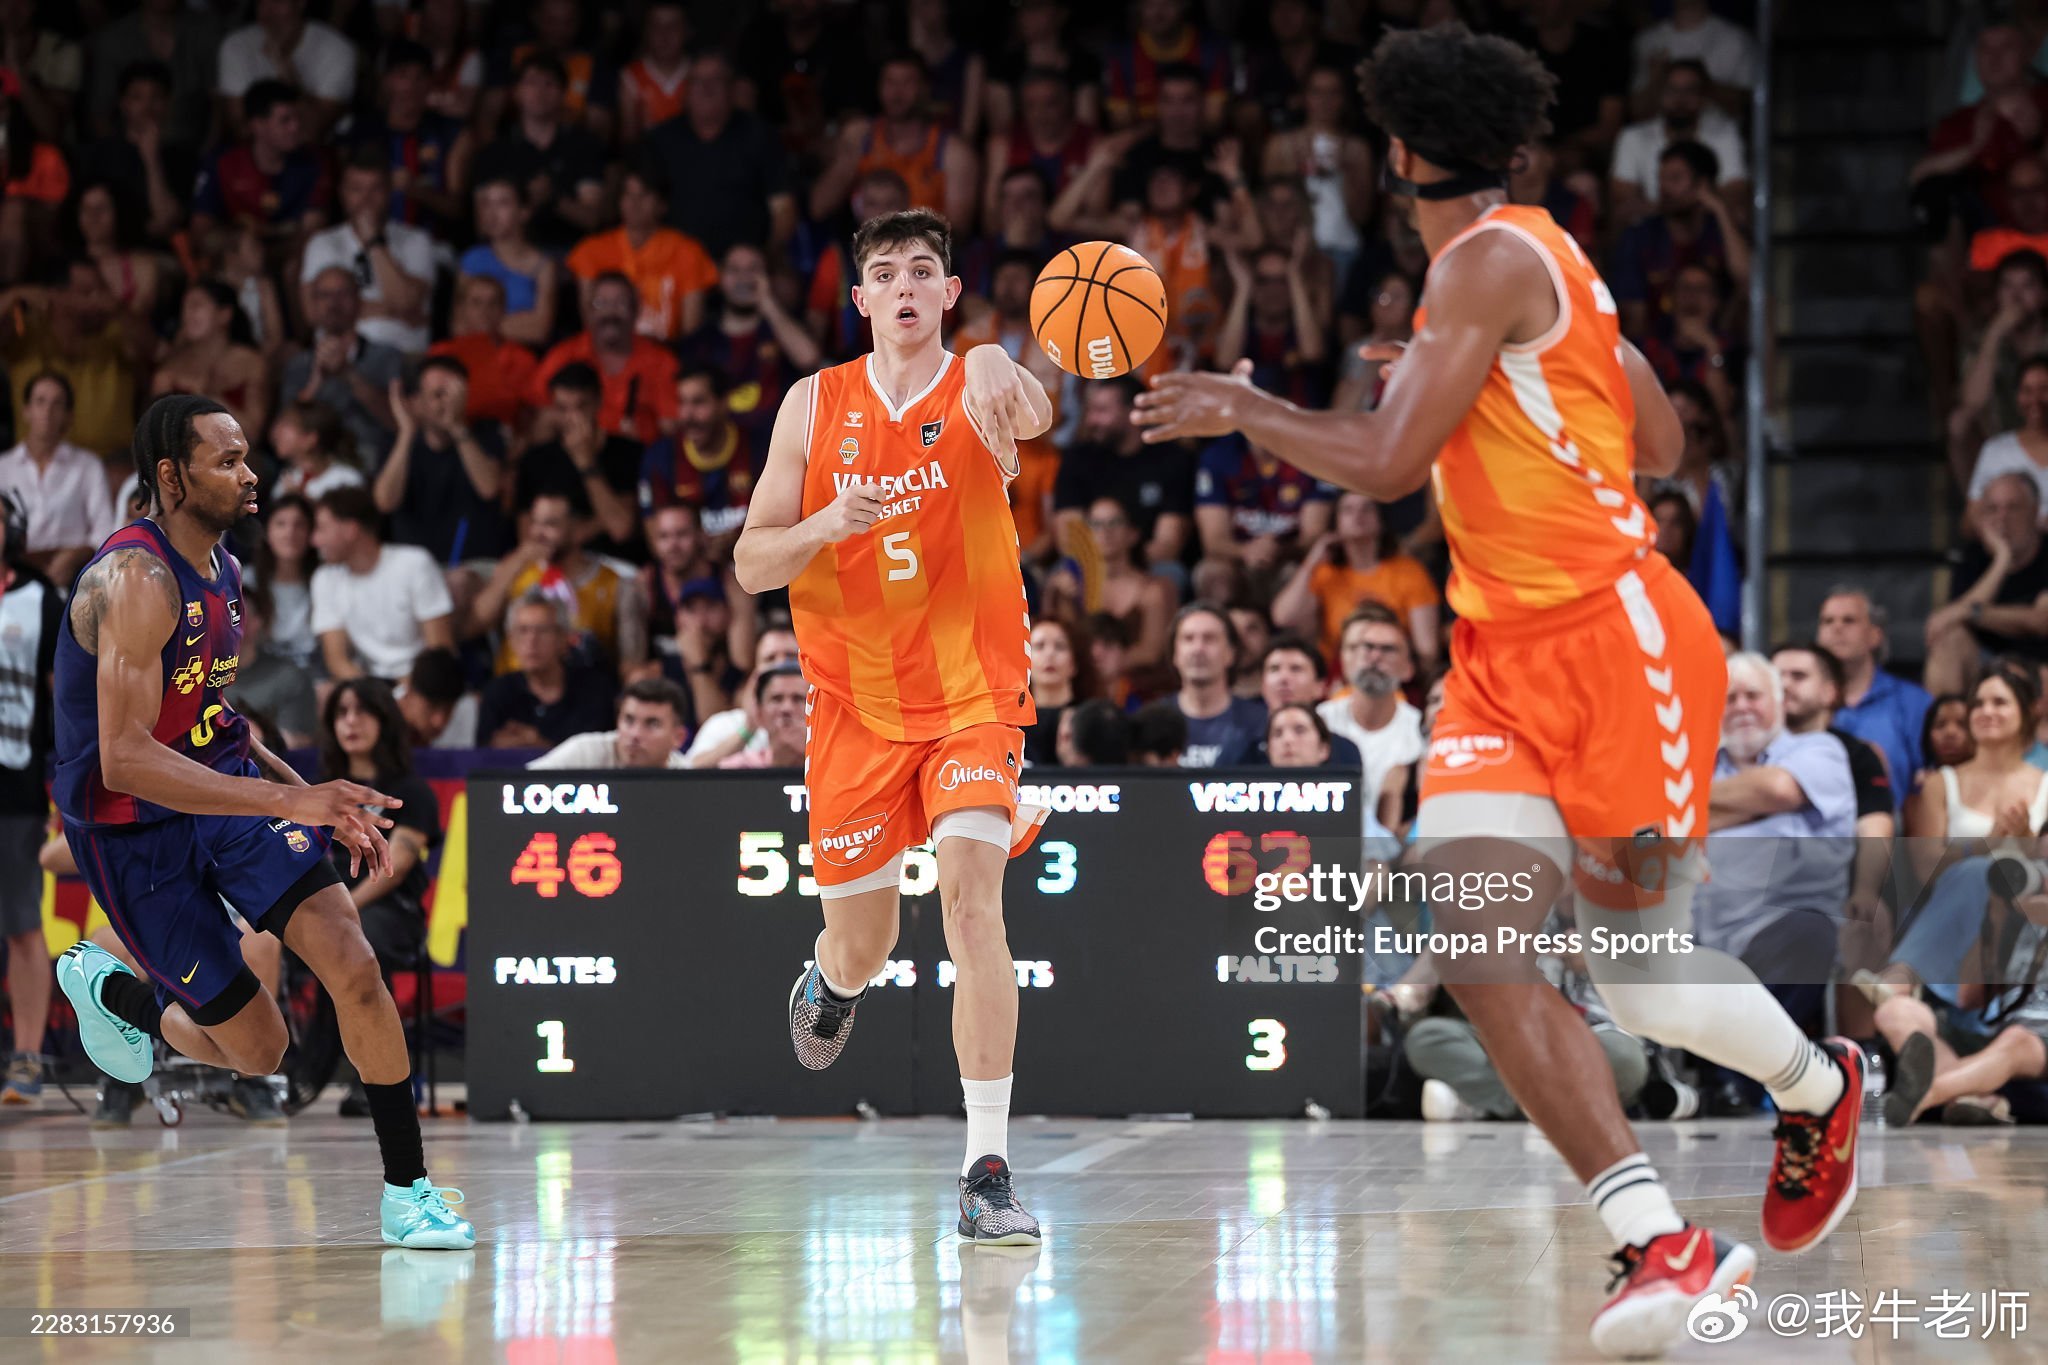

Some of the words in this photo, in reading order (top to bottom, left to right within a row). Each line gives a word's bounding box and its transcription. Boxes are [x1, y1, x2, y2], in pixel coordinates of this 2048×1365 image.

[832, 461, 949, 500] VAENCIA
[882, 531, 918, 581] 5
[939, 759, 1004, 790] Midea
[503, 784, 619, 814] LOCAL
[1189, 782, 1352, 812] VISITANT
[511, 832, 622, 898] 46
[1037, 841, 1078, 894] 3
[1202, 830, 1311, 896] 62
[495, 956, 617, 984] FALTES
[1216, 955, 1339, 983] FALTES
[536, 1020, 574, 1072] 1
[1245, 1018, 1288, 1071] 3
